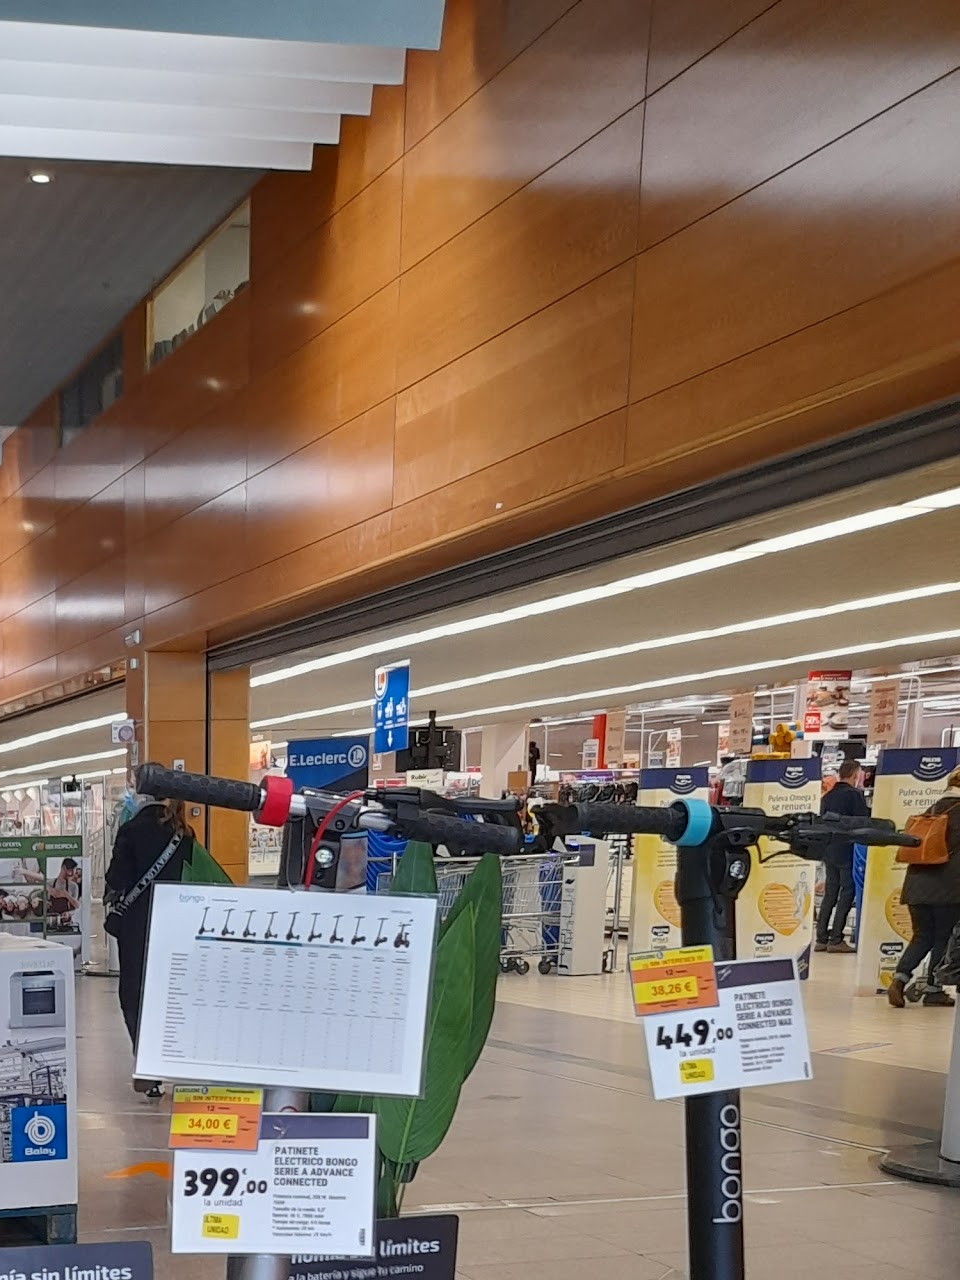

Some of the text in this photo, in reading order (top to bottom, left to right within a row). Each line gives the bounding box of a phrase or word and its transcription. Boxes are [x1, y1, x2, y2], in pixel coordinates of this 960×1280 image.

[289, 753, 347, 767] E.Leclerc
[899, 788, 923, 797] Puleva
[768, 795, 788, 803] Puleva
[790, 794, 811, 803] Omega
[782, 803, 812, 811] renueva
[651, 984, 681, 996] 38,26
[734, 991, 766, 1001] PATINETE
[735, 999, 793, 1011] ELECTRICO BONGO
[736, 1012, 755, 1021] SERIE
[763, 1008, 792, 1018] ADVANCE
[737, 1019, 777, 1031] CONNECTED
[188, 1118, 231, 1130] 34,00 €
[24, 1147, 56, 1157] Balay
[275, 1147, 319, 1155] PATINETE
[274, 1157, 358, 1166] ELECTRICO BONGO
[713, 1104, 741, 1223] bongo
[274, 1167, 354, 1177] SERIE A ADVANCE
[273, 1178, 328, 1186] CONNECTED
[204, 1198, 242, 1206] la unidad
[380, 1238, 440, 1258] límites
[342, 1271, 349, 1280] y
[389, 1263, 424, 1274] camino
